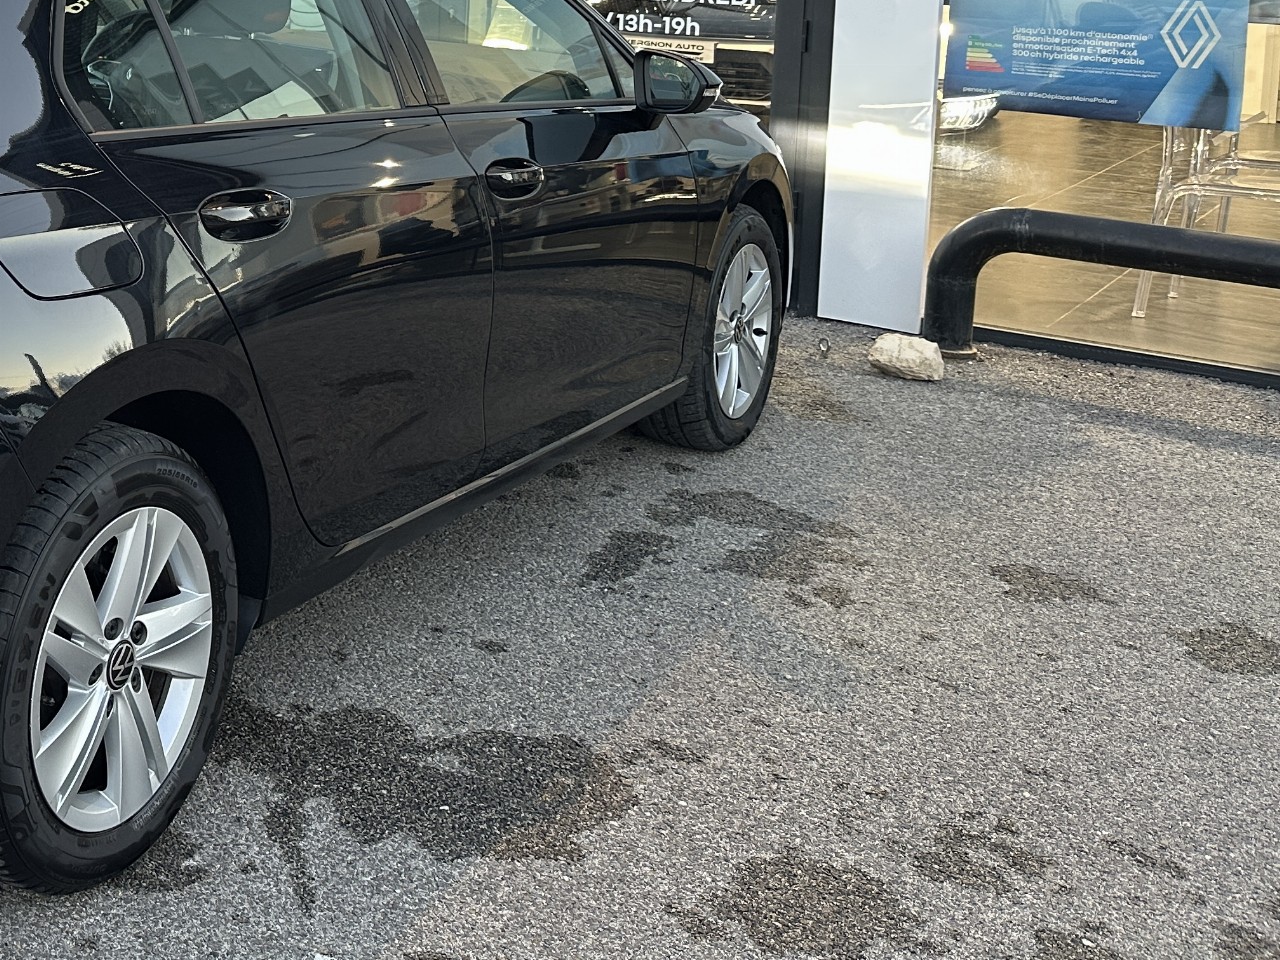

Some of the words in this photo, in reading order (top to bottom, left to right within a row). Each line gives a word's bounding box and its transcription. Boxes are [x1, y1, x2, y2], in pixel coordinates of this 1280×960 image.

[675, 43, 705, 51] AUTO
[1012, 33, 1060, 44] disponible
[1061, 37, 1136, 49] prochainement
[1012, 48, 1030, 57] 300
[1043, 51, 1079, 61] hybride
[1080, 54, 1145, 66] rechargeable
[1025, 43, 1086, 53] motorisation
[1087, 46, 1119, 56] E-Tech
[1120, 49, 1138, 57] 4x4
